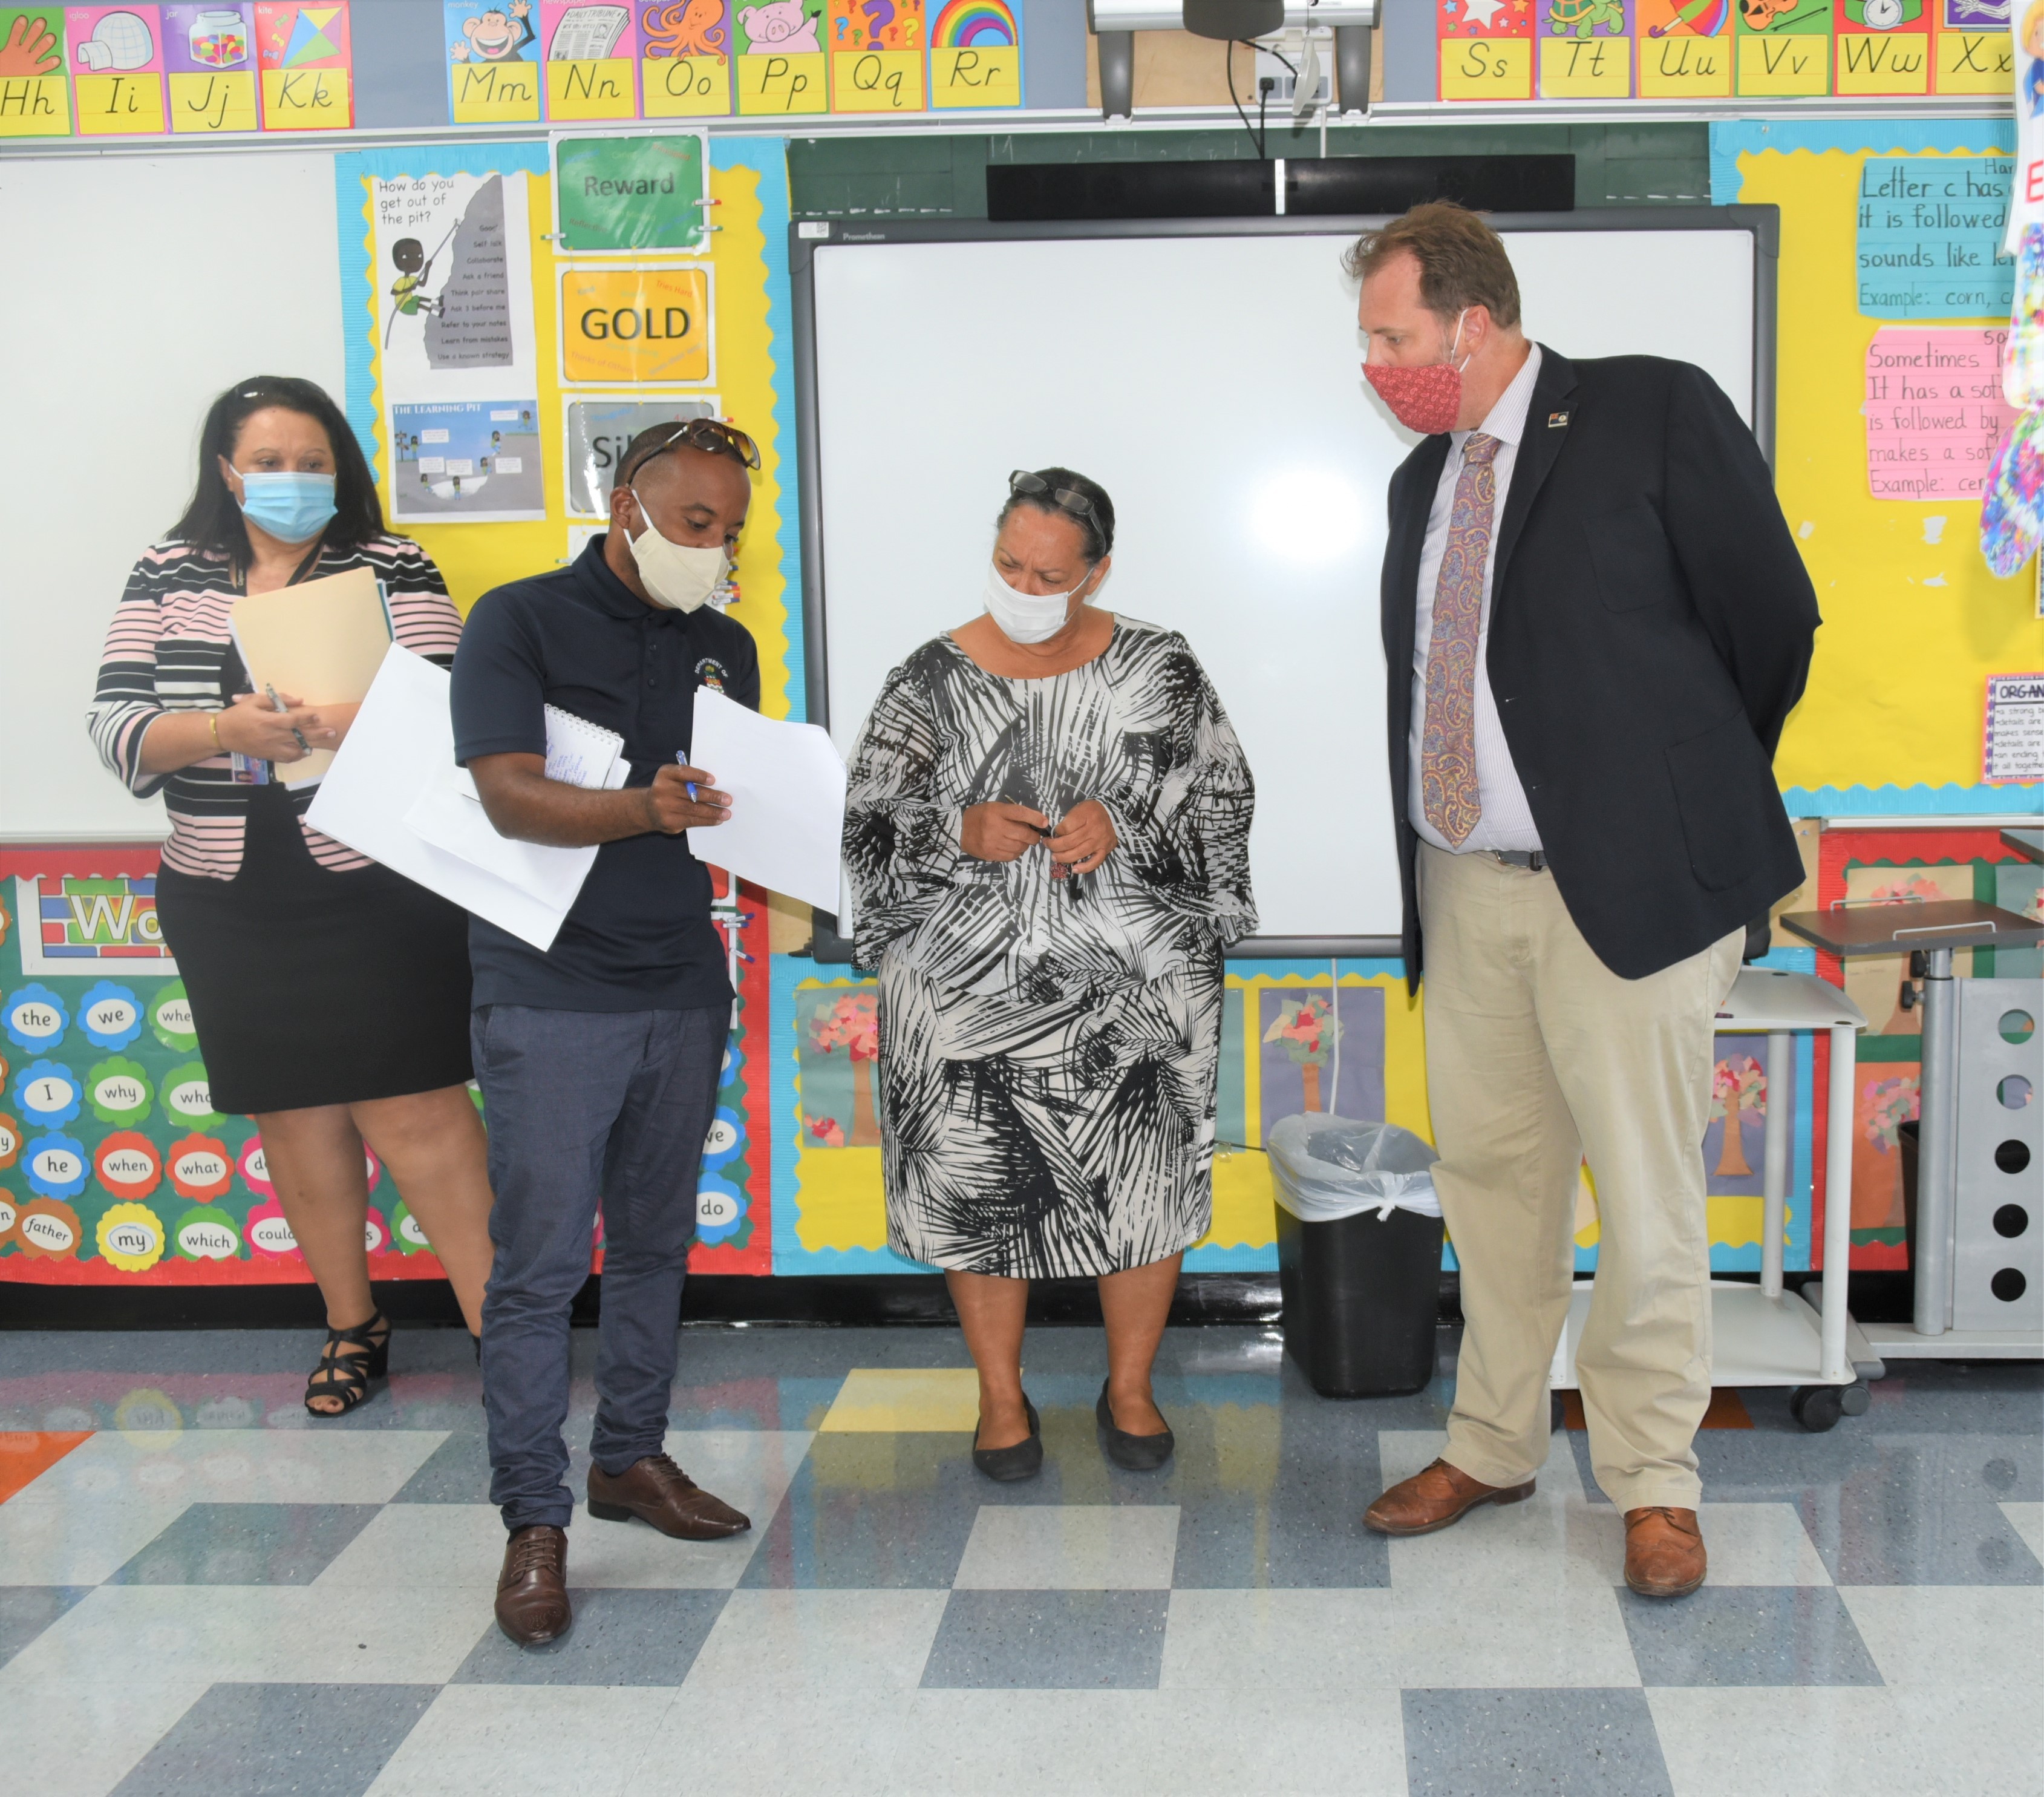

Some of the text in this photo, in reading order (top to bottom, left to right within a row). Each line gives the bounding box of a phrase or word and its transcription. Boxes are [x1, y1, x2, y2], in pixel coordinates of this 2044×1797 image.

[69, 11, 90, 21] igloo
[165, 10, 178, 20] jar
[258, 5, 273, 15] kite
[569, 9, 617, 19] DAILY TRIBUNE
[1461, 42, 1508, 77] Ss
[1567, 40, 1604, 77] Tt
[1660, 39, 1716, 76] Uu
[1763, 38, 1809, 74] Vv
[1845, 37, 1922, 73] Ww
[666, 61, 711, 96] Oo
[854, 54, 903, 107] Qq
[950, 50, 1001, 87] Rr
[278, 72, 333, 109] Kk
[461, 66, 532, 103] Mm
[564, 64, 621, 100] Nn
[761, 57, 808, 110] Pp
[0, 79, 55, 116] Hh
[105, 77, 139, 114] Ii
[188, 76, 230, 128] Jj
[379, 180, 454, 192] How do you
[584, 172, 674, 197] Reward
[1862, 166, 1933, 198] Letter
[1944, 183, 1957, 197] c
[1967, 171, 2003, 197] has
[380, 193, 446, 212] get out of
[382, 211, 431, 227] the pit?
[1859, 204, 2006, 228] it is followed
[1859, 244, 1934, 268] sounds
[1947, 242, 1980, 267] like
[656, 280, 693, 298] Tries Hard
[1860, 281, 1930, 316] Example:
[1946, 292, 1990, 309] corn,
[581, 307, 691, 339] GOLD
[482, 352, 509, 360] strategy
[571, 351, 597, 366] Thinks
[598, 358, 607, 367] of
[1869, 341, 1980, 368] Sometimes
[1868, 376, 1889, 400] It
[1902, 375, 1938, 400] has
[1950, 386, 1964, 398] a
[394, 403, 482, 414] THE LEARNING PIT
[1870, 405, 1998, 436] is followed by
[1869, 437, 1928, 462] makes
[1944, 448, 1954, 460] a
[1870, 468, 1944, 499] Example:
[694, 658, 728, 678] DEPARTMENT OF
[2009, 707, 2034, 718] strong
[2012, 751, 2038, 761] ending
[22, 1009, 51, 1026] the
[98, 1010, 125, 1024] we
[44, 1084, 53, 1101] I
[104, 1086, 136, 1102] why
[47, 1156, 68, 1173] he
[109, 1158, 148, 1172] when
[181, 1160, 220, 1175] what
[701, 1199, 723, 1215] do
[25, 1219, 69, 1242] father
[186, 1233, 231, 1249] which
[118, 1234, 146, 1252] my
